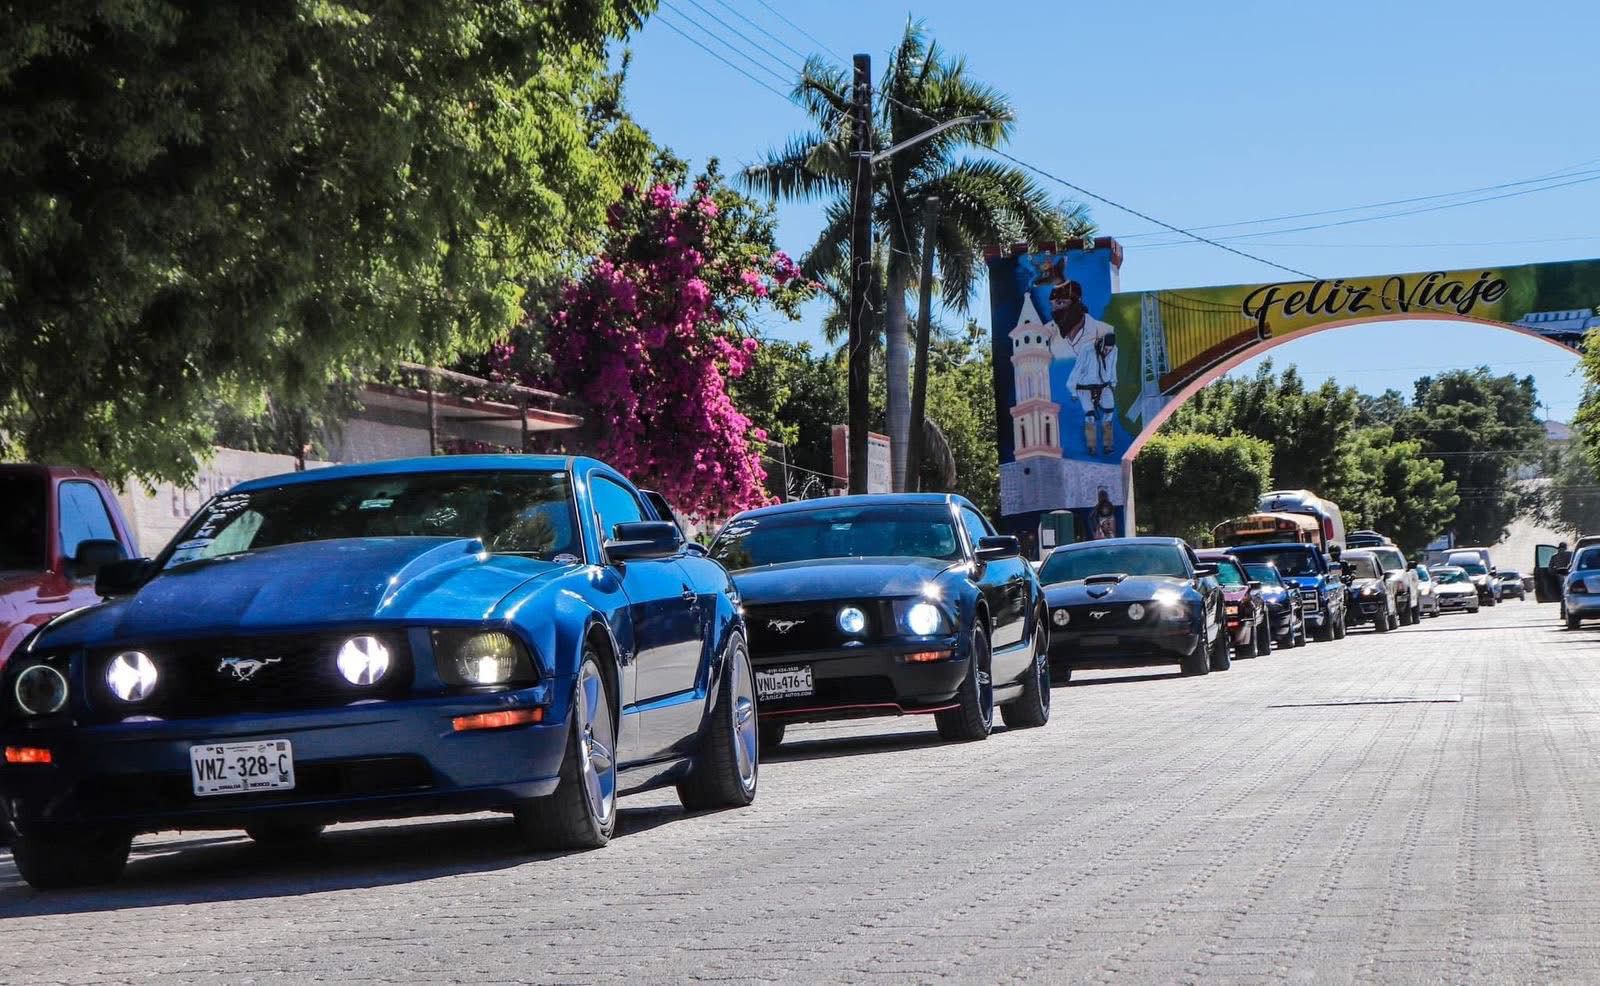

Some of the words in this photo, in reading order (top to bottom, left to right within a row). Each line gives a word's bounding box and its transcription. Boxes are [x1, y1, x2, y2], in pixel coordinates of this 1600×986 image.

[1242, 279, 1375, 342] Feliz
[1381, 270, 1511, 316] Viaje
[757, 674, 812, 691] VNU-476-C
[195, 754, 289, 781] VMZ-328-C
